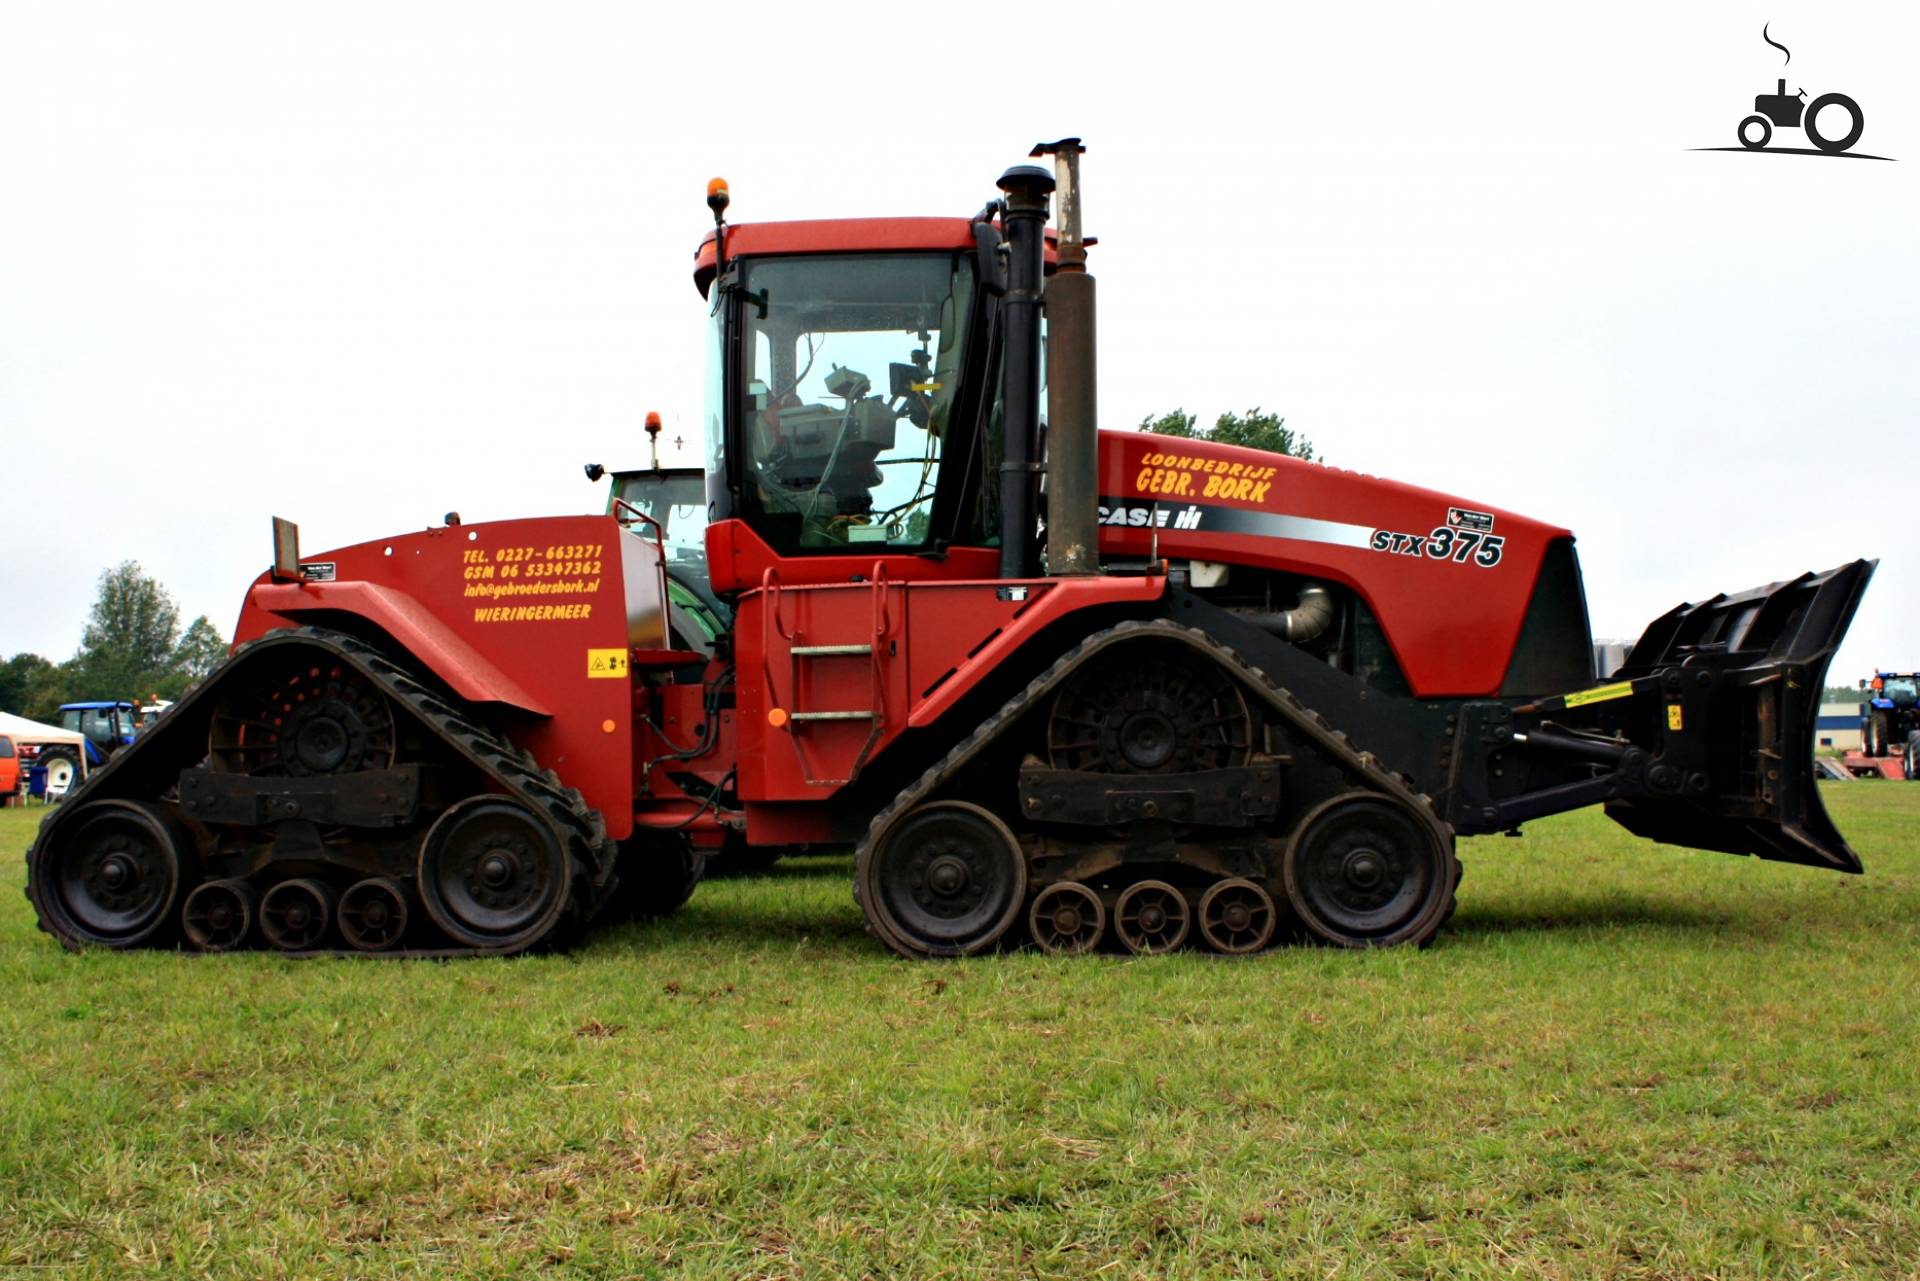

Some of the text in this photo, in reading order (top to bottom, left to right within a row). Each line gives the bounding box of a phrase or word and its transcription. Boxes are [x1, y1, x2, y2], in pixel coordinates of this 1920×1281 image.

[1141, 453, 1277, 480] LOONBEDRIJF
[1136, 467, 1271, 503] GEBR. BORK
[463, 550, 489, 563] TEL.
[1426, 526, 1506, 568] 375
[463, 560, 601, 579] GSM 06 53347362
[464, 578, 601, 600] info@gebroedersbork.nl
[474, 604, 592, 622] WIERINGERMEER
